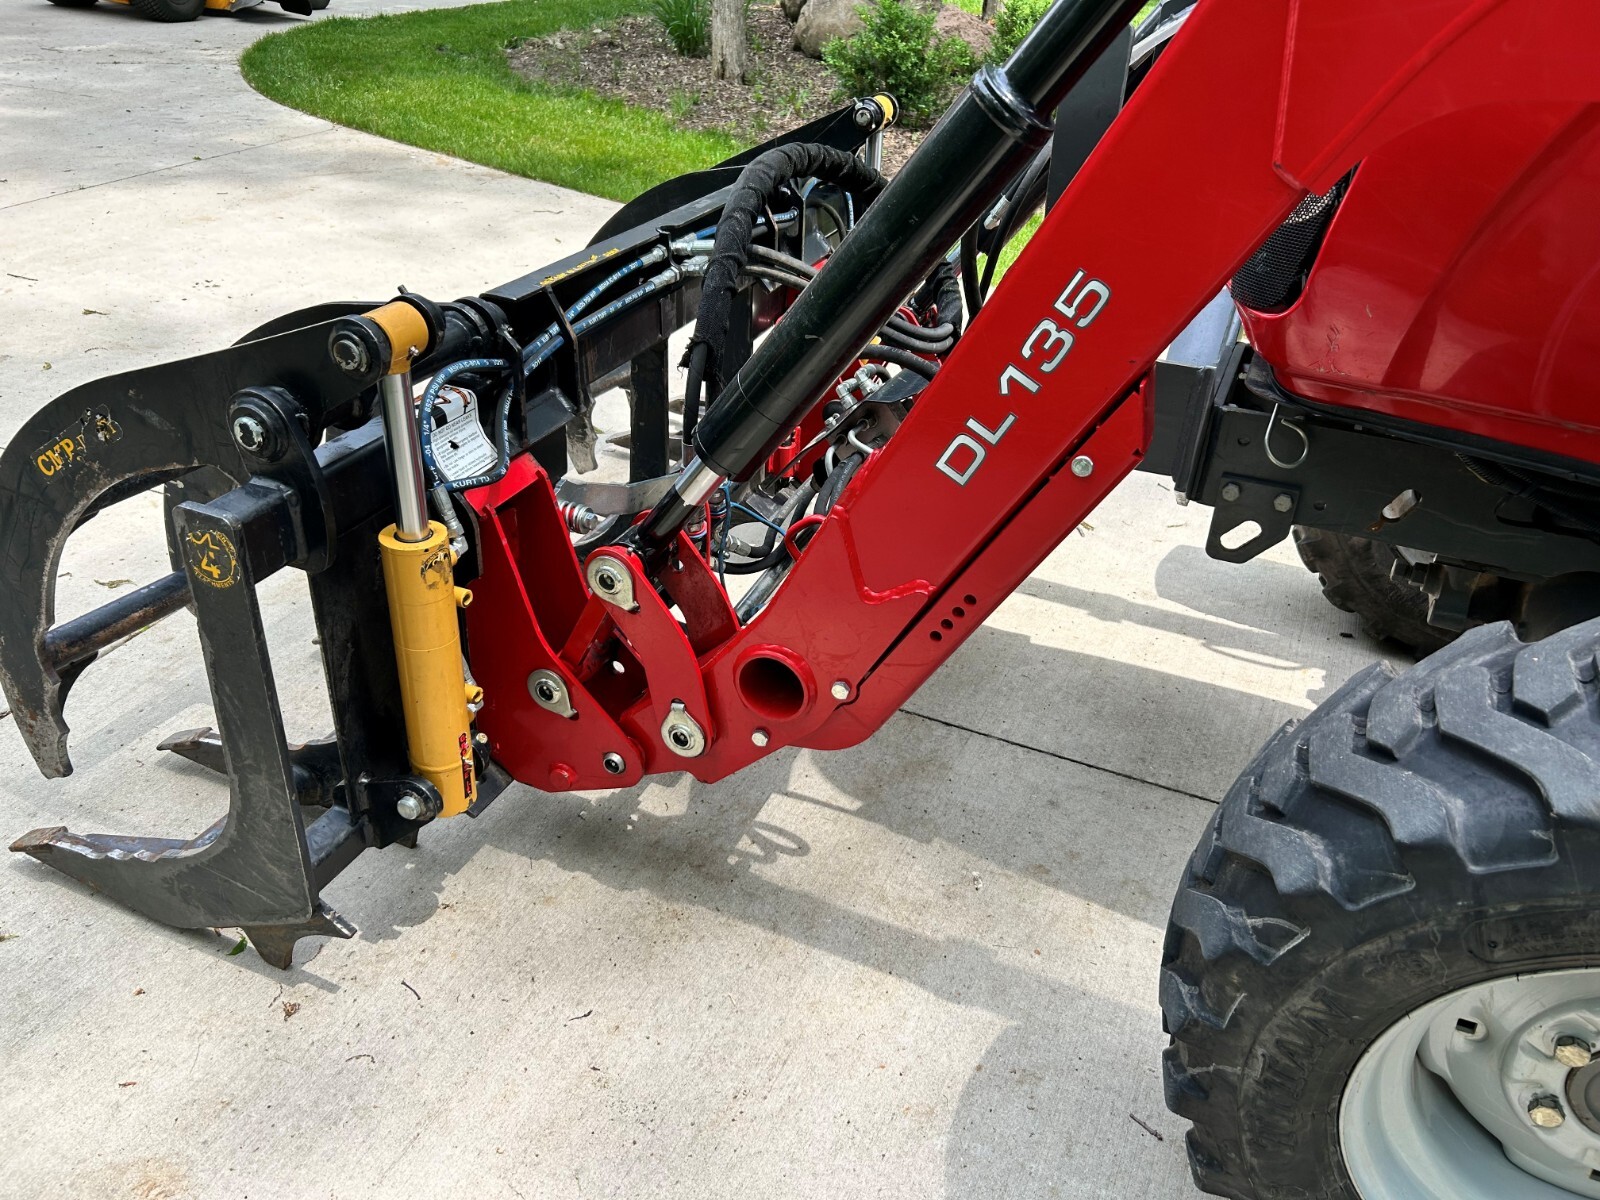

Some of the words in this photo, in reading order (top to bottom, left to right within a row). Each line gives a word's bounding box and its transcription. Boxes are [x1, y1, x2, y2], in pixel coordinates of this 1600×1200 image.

[935, 412, 1018, 487] DL
[998, 267, 1112, 396] 135
[431, 382, 441, 395] PSI
[452, 479, 478, 489] KURT
